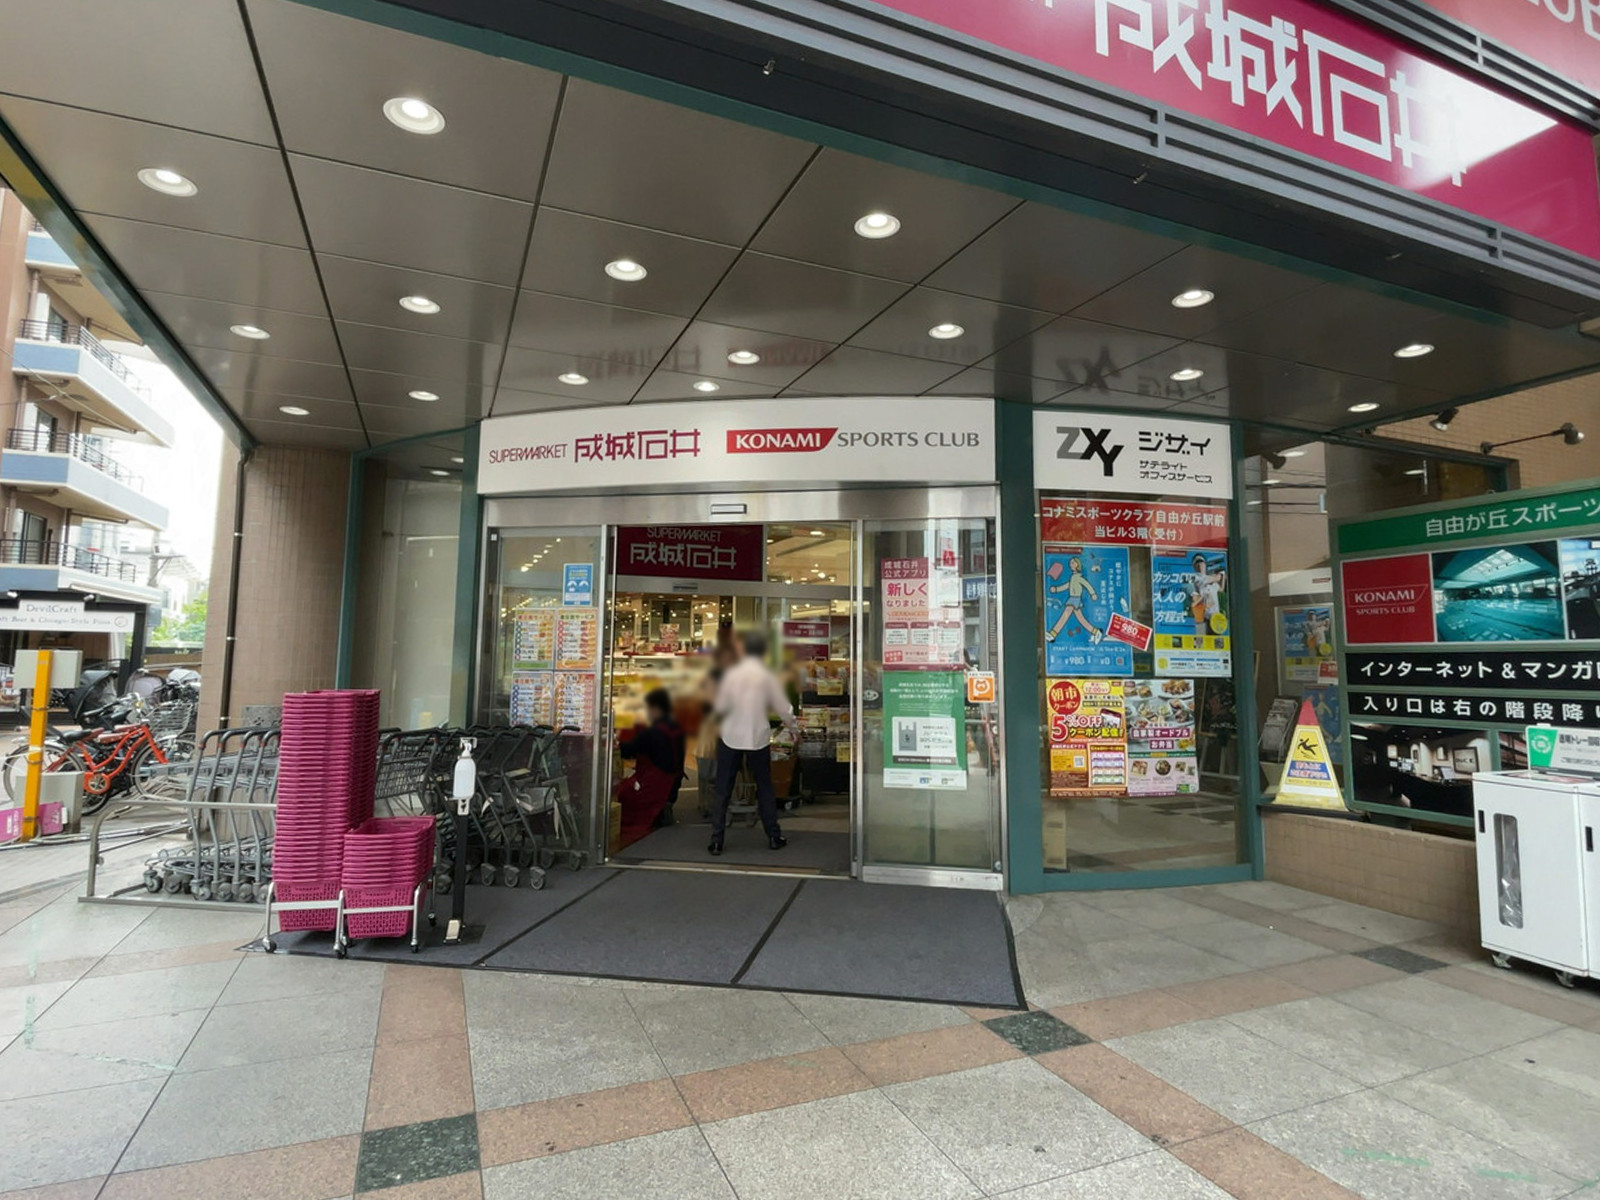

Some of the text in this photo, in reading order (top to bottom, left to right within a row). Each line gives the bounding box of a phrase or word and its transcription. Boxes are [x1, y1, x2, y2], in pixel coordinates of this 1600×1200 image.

[1095, 0, 1467, 187] 成城石井
[574, 428, 701, 463] 成城石井
[735, 430, 981, 449] KONAMI SPORTS CLUB
[1138, 431, 1211, 456] ジザイ
[489, 443, 568, 464] SUPERMARKET
[1056, 426, 1125, 477] ZXY
[1139, 460, 1188, 471] サテライト
[1139, 470, 1213, 484] オフィスサービス
[1042, 505, 1225, 528] コナミスポーツクラブ自由が丘駅前
[646, 525, 722, 543] SUPERMARKET
[630, 542, 737, 570] 成城石井
[887, 582, 928, 596] 新しく
[1355, 589, 1415, 604] KONAMI
[886, 599, 927, 608] なりました
[1356, 605, 1415, 615] SPORTS CLUB
[1360, 660, 1600, 680] インターネット&マンガ
